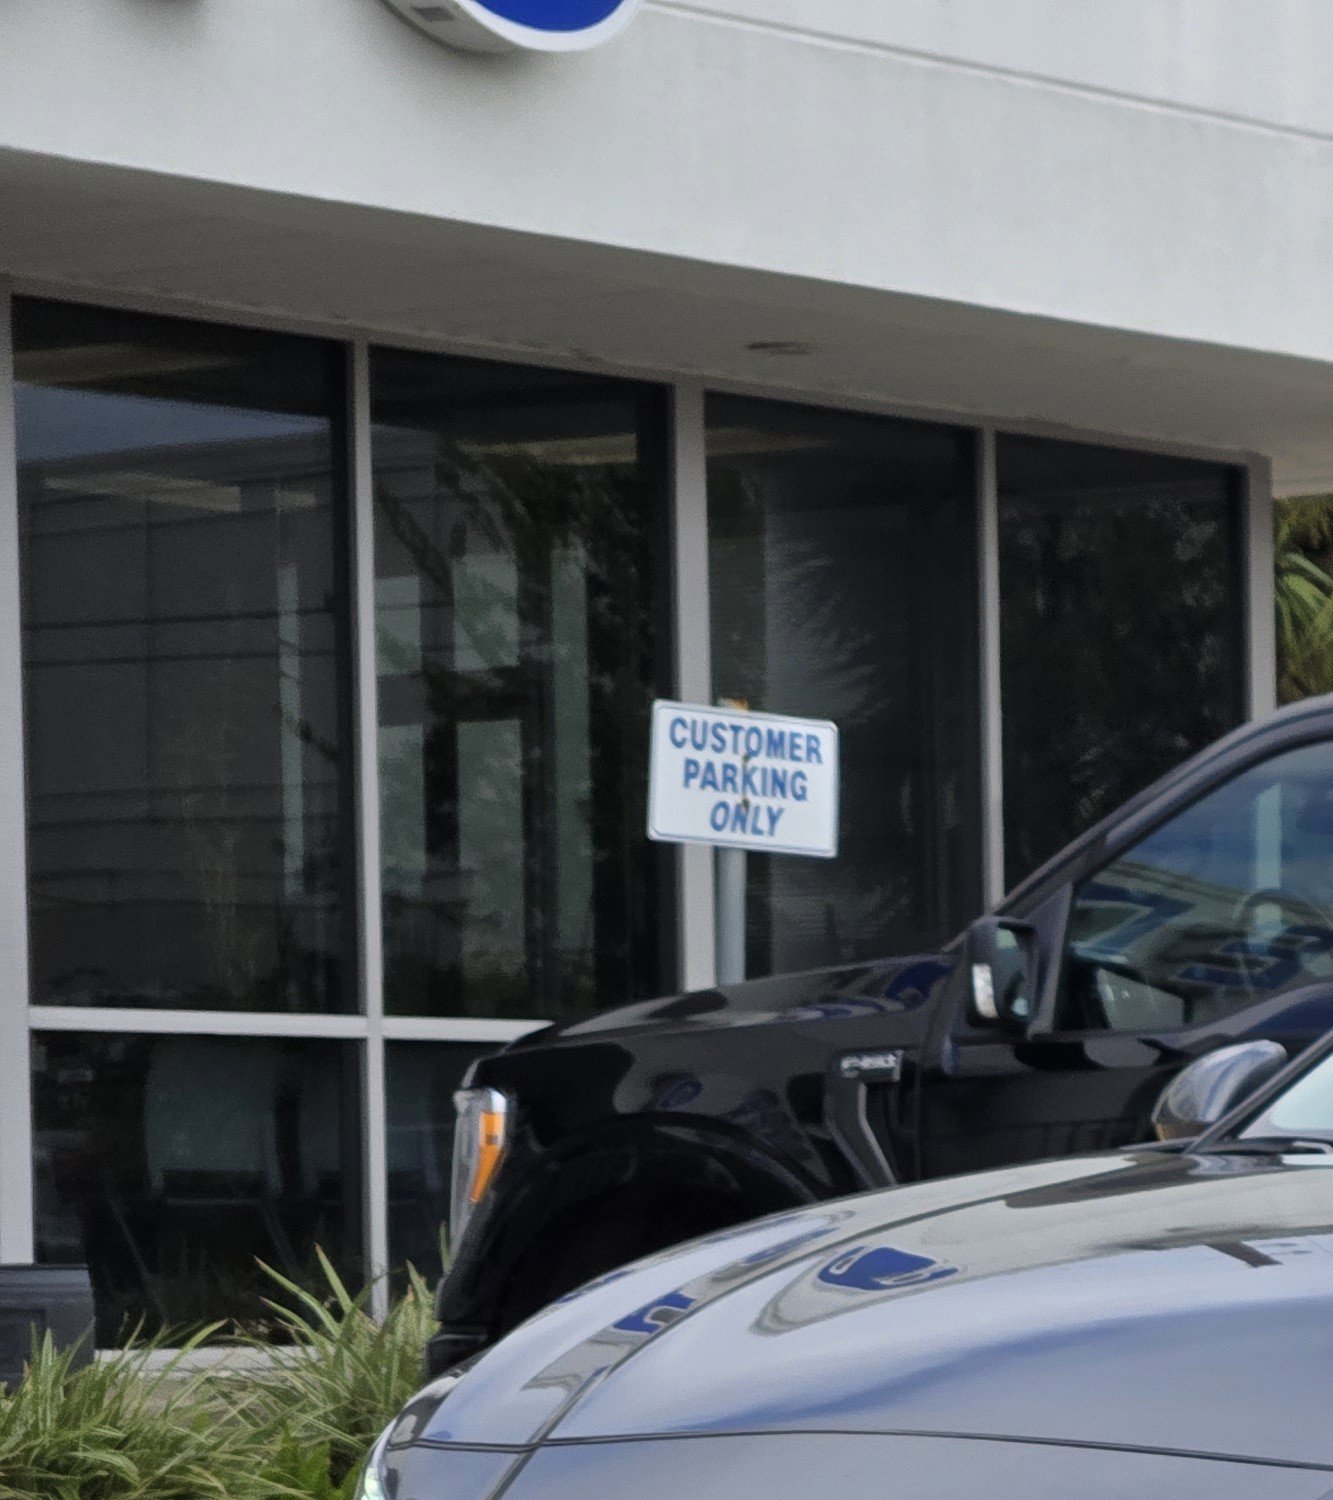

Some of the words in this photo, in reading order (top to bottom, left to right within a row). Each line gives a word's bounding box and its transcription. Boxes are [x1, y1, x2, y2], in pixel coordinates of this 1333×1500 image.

[669, 718, 822, 763] CUSTOMER
[684, 758, 808, 801] PARKING
[710, 801, 785, 836] ONLY
